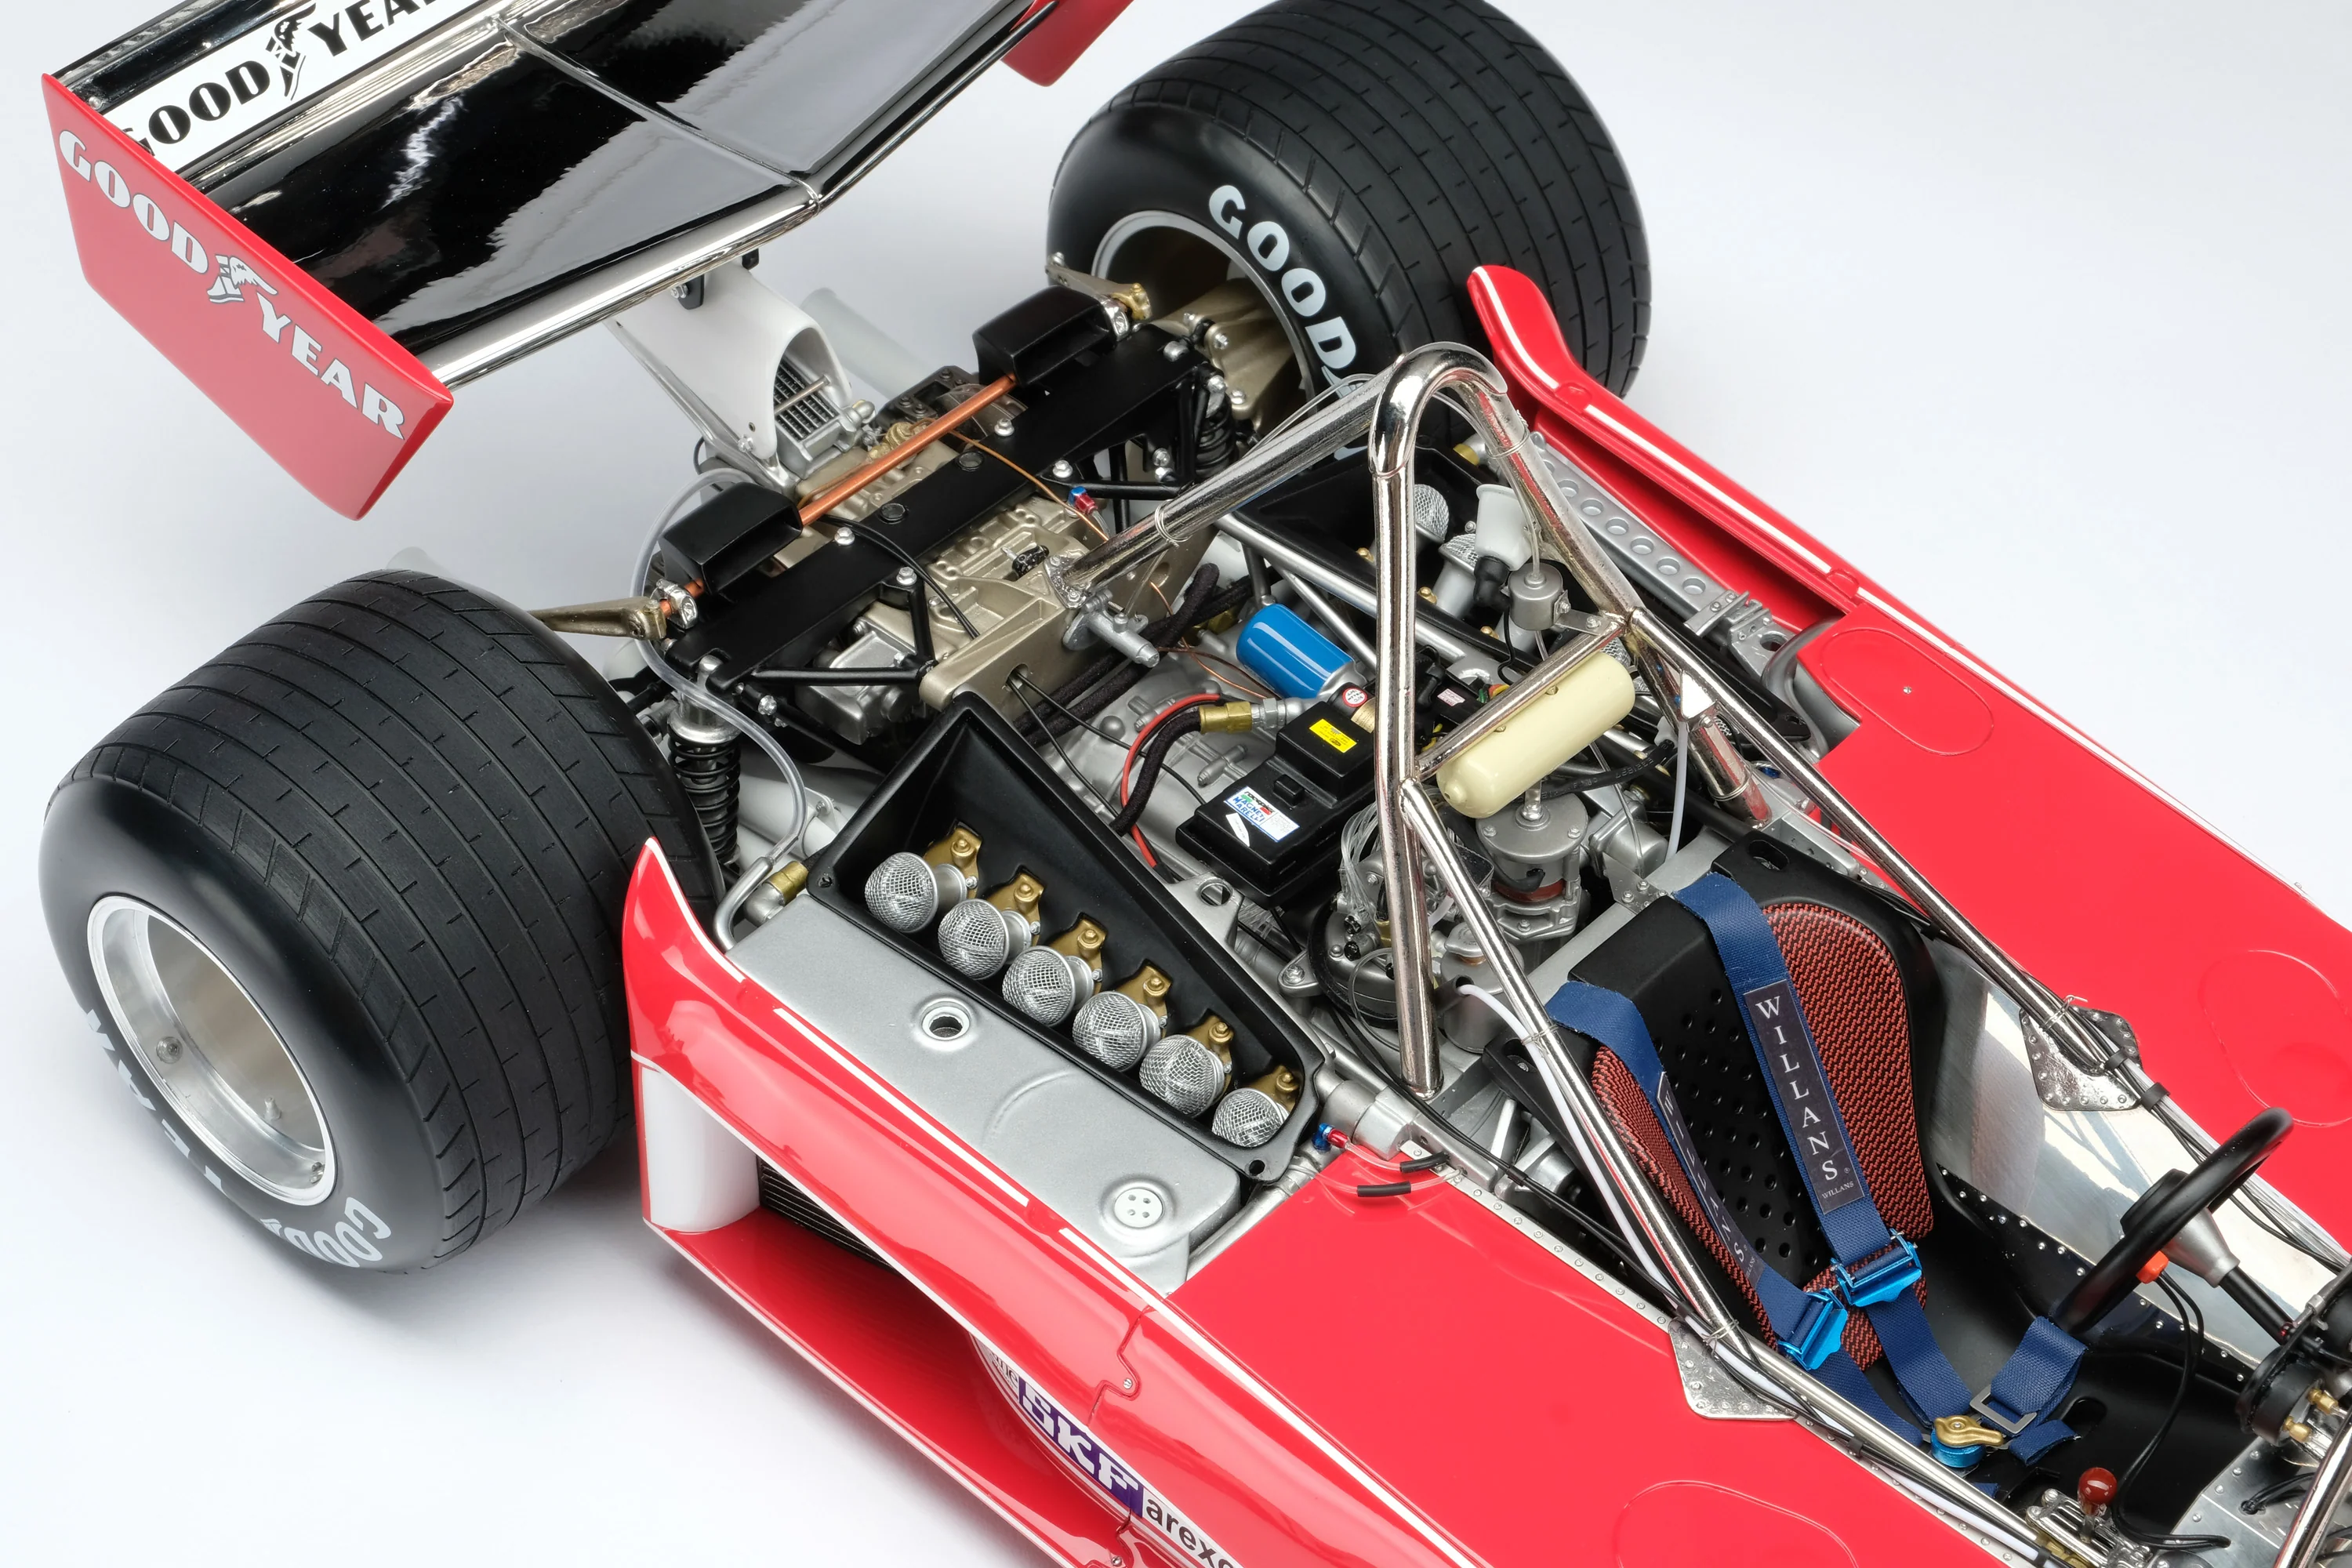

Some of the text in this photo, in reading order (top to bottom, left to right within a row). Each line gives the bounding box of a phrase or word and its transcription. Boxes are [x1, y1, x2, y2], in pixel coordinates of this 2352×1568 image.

[307, 0, 437, 56] YEA
[59, 129, 405, 441] GOOD YEAR
[1208, 184, 1357, 369] GOOD
[1755, 996, 1839, 1181] WILLANS
[284, 1196, 392, 1268] GOOD
[1821, 1181, 1854, 1199] WILLANS
[1022, 1382, 1139, 1491] SKF
